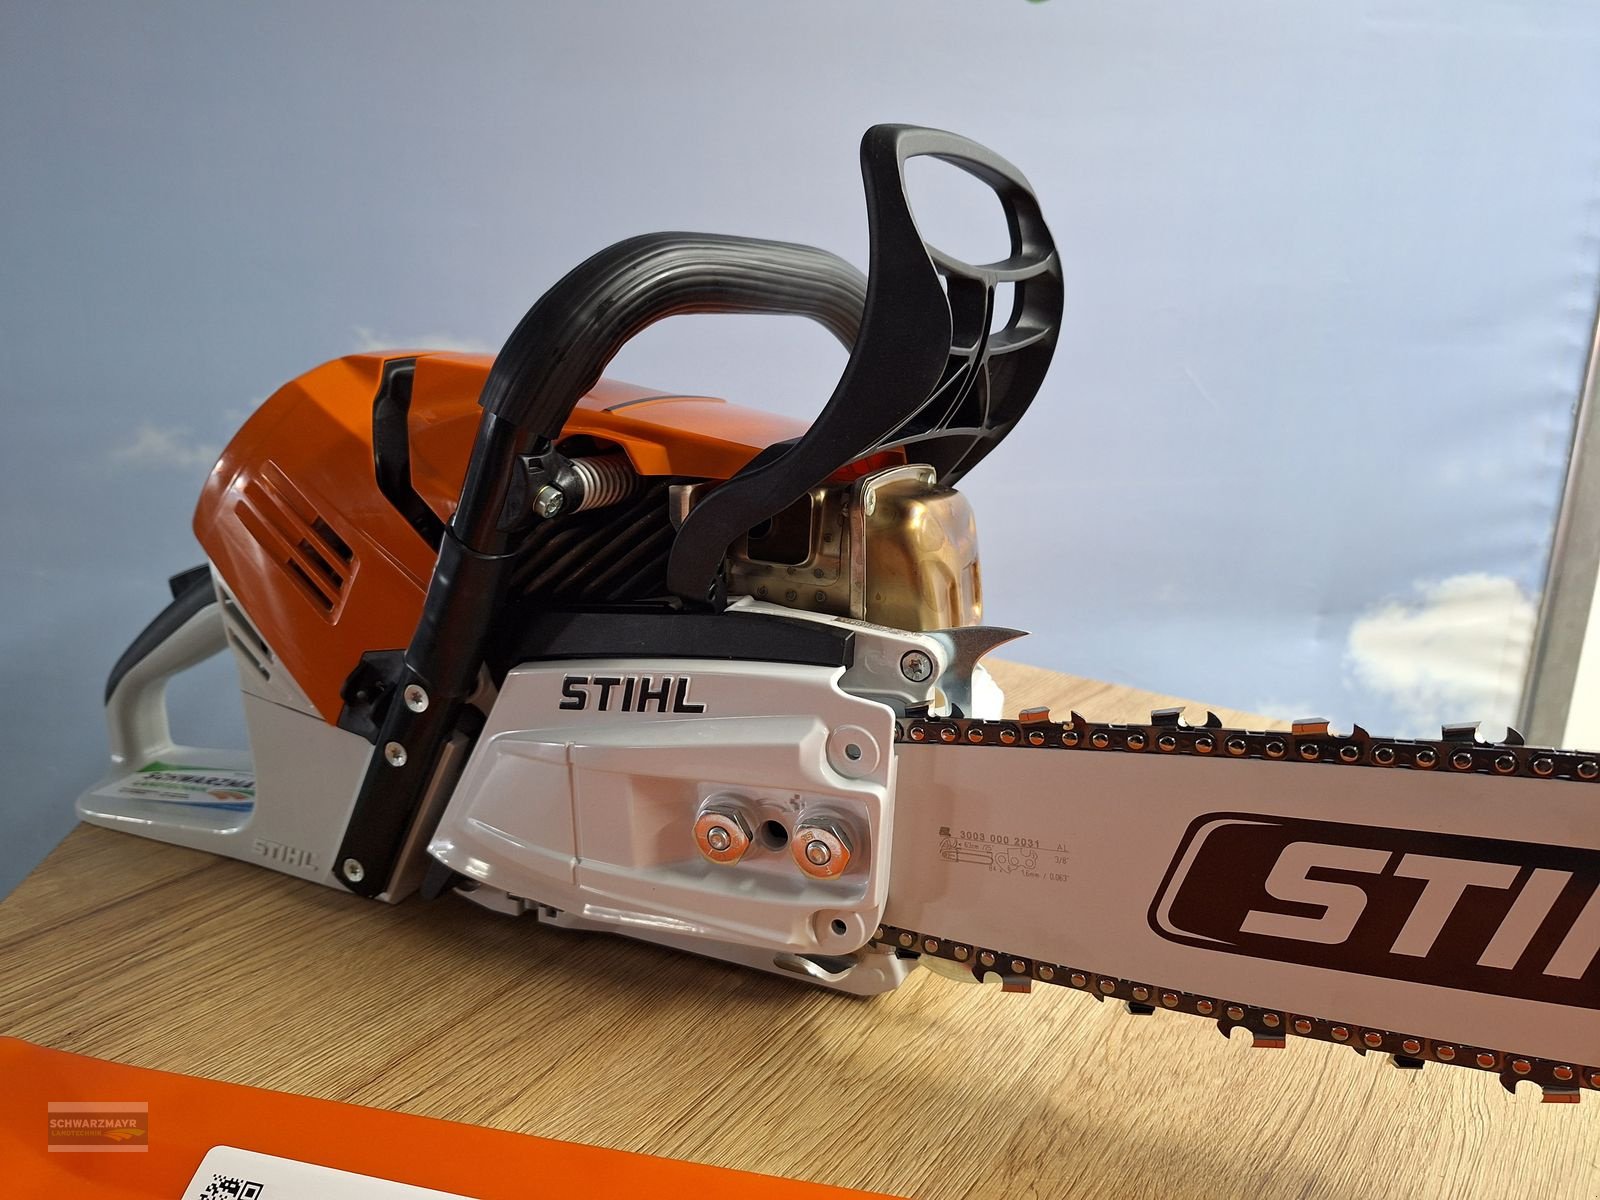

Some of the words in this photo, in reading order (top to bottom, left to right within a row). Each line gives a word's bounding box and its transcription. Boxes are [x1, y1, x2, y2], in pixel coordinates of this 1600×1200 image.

[559, 676, 707, 714] STIHL
[256, 838, 319, 871] STIHL
[960, 830, 985, 841] 3003
[990, 834, 1009, 844] 000
[1014, 837, 1040, 848] 2031
